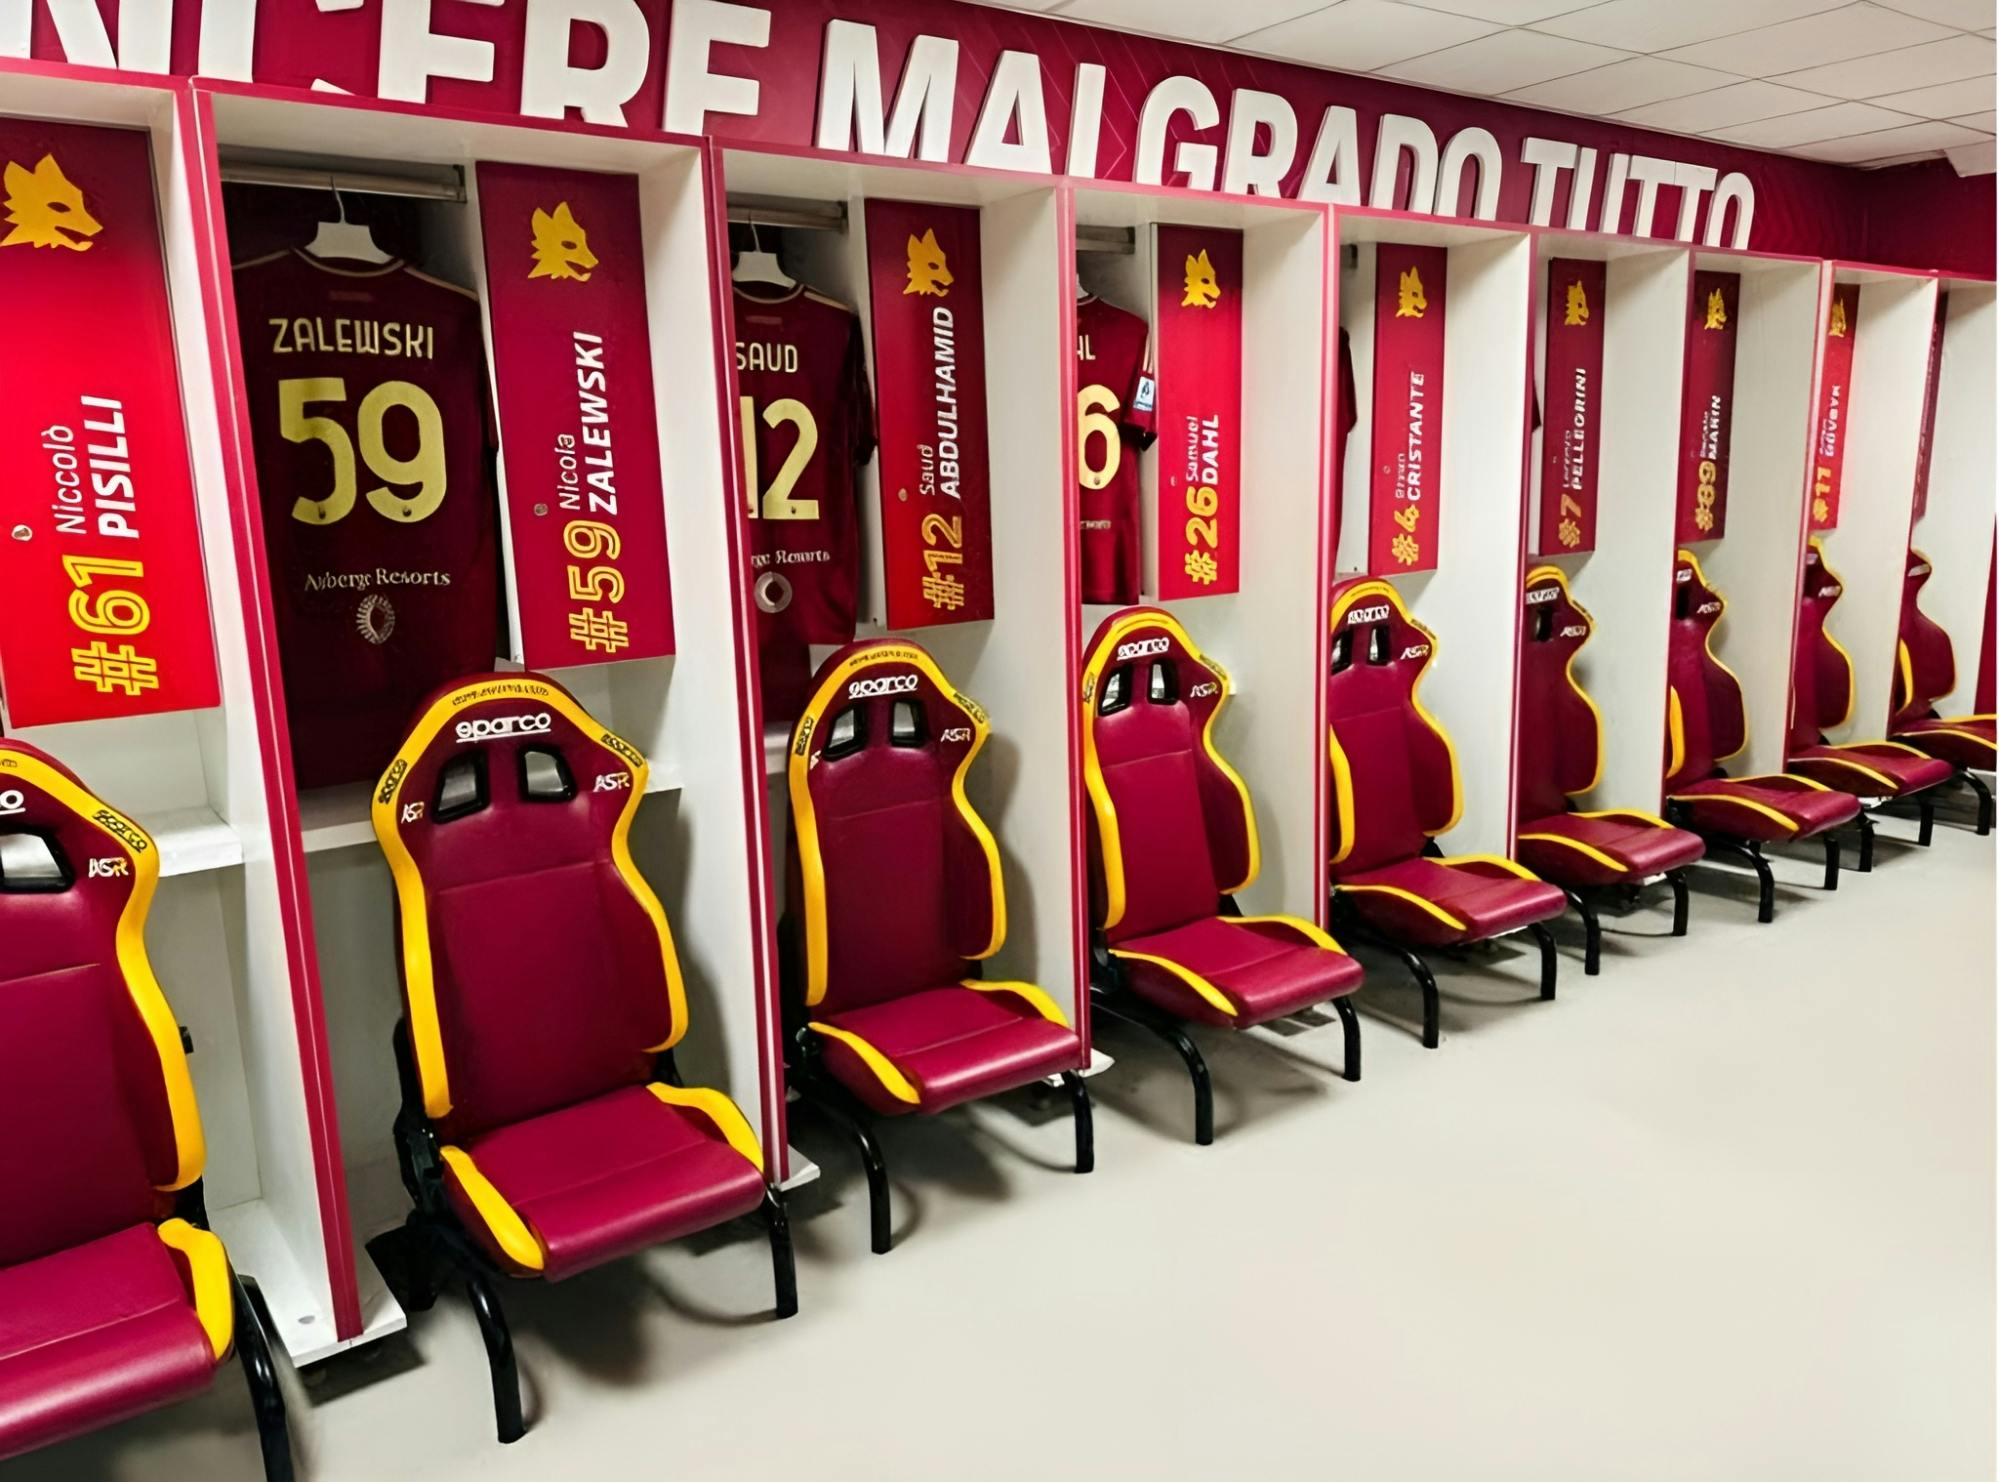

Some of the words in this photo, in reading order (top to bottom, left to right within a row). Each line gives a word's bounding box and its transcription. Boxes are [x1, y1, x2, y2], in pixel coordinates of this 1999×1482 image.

[1521, 134, 1757, 252] TUTTO
[268, 316, 434, 360] ZALEWSKI
[736, 341, 799, 374] SAUD
[278, 376, 447, 525] 59
[573, 330, 618, 517] ZALEWSKI
[932, 305, 961, 500] ABDULHAMID
[1078, 383, 1121, 490] 6
[1200, 414, 1219, 486] DAHL
[1406, 371, 1425, 501] CRISTANTE
[40, 423, 88, 536] Niccolò
[80, 394, 140, 540] PISILLI
[554, 432, 580, 511] Nicola
[916, 443, 935, 496] Saud
[563, 519, 630, 653] #59
[921, 512, 965, 612] #12
[1184, 485, 1219, 586] #26
[61, 553, 160, 696] #61
[592, 772, 631, 792] ASR
